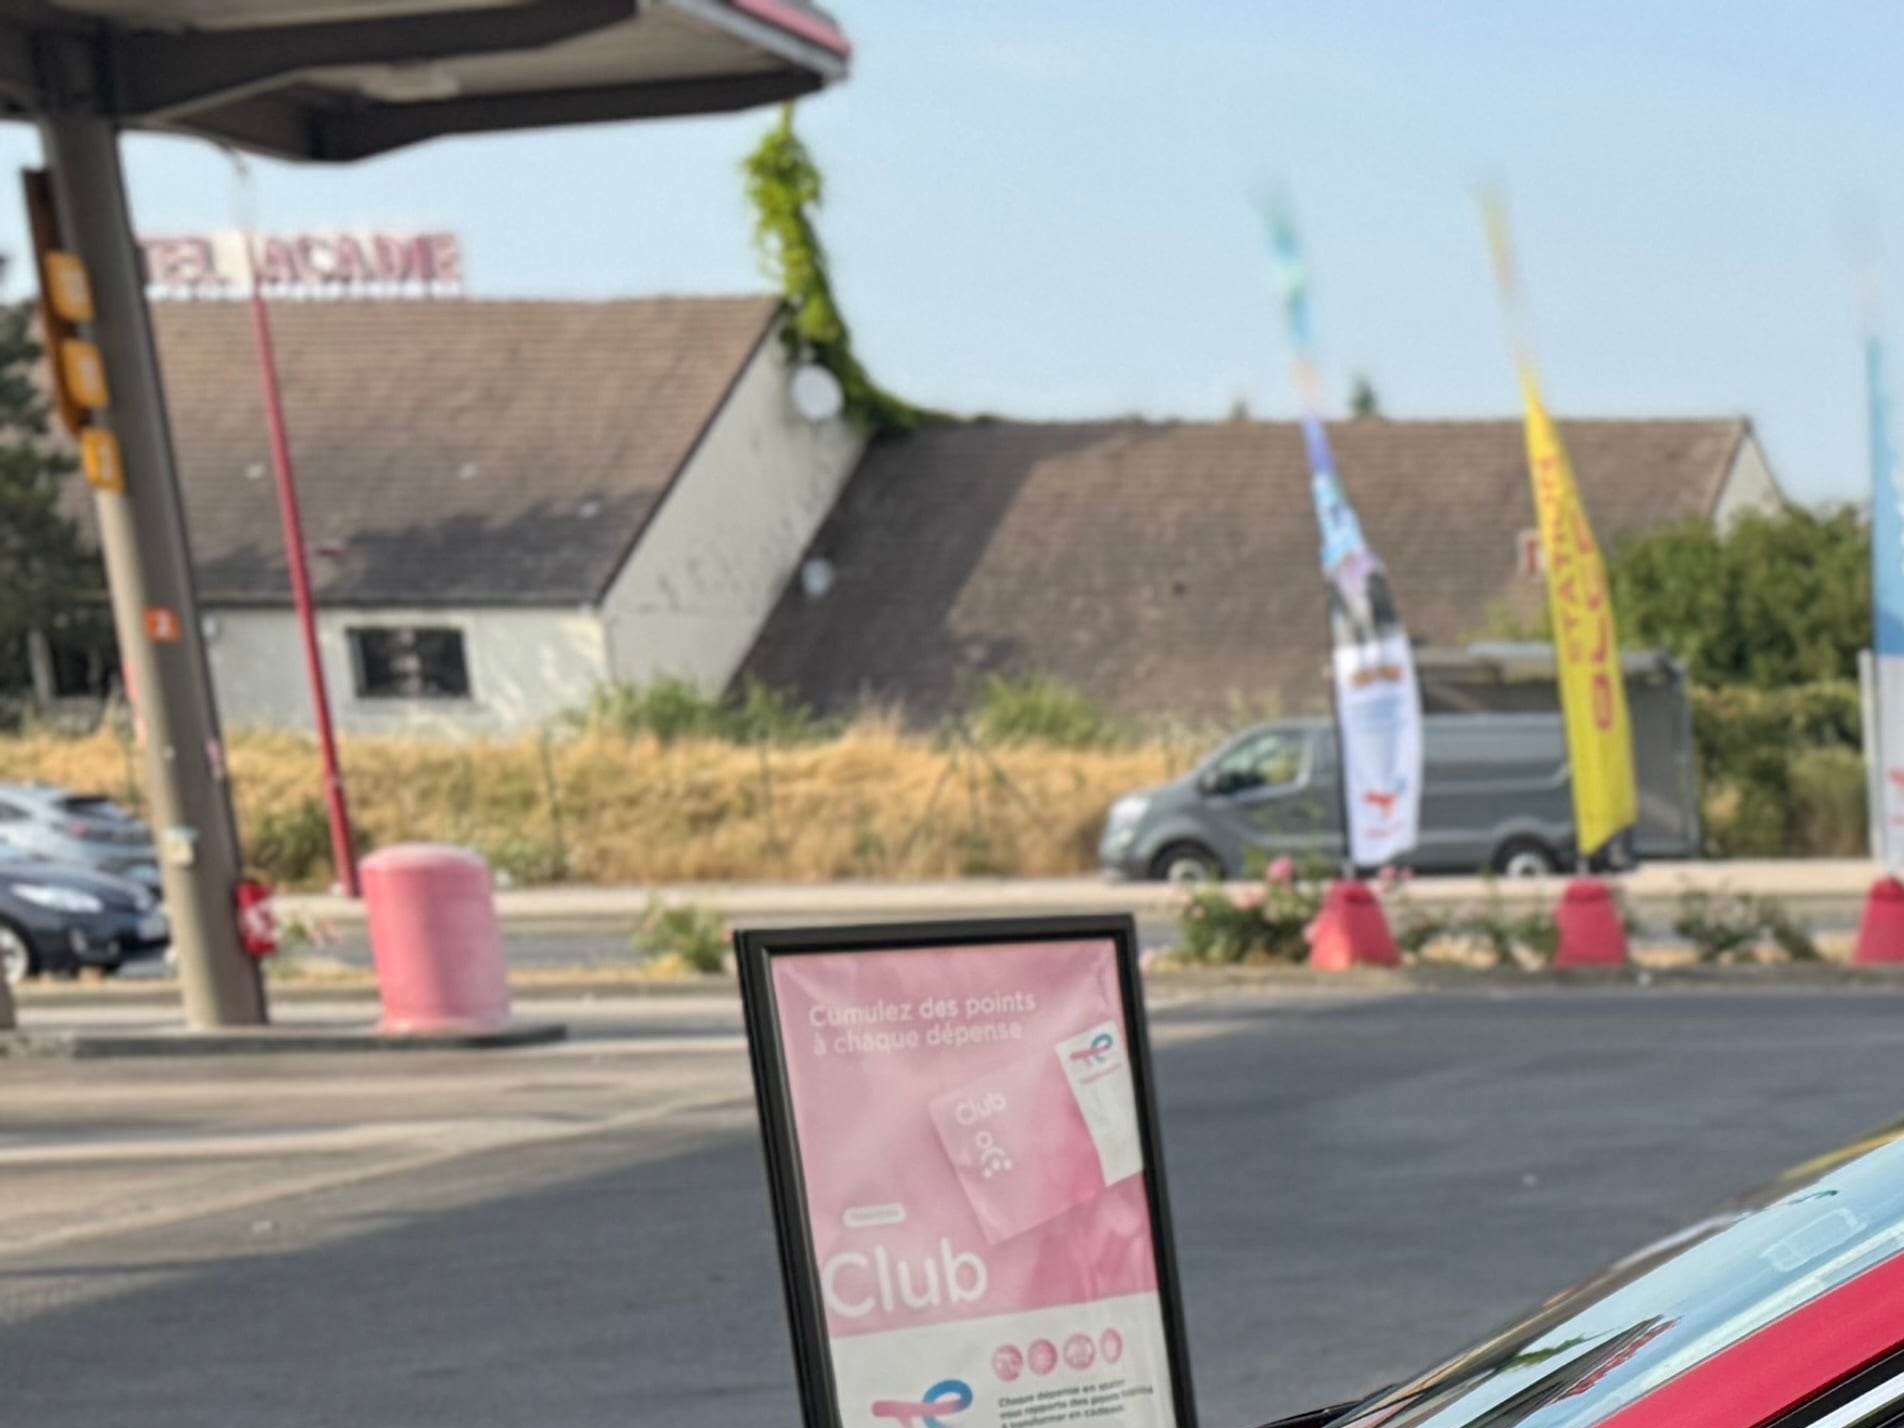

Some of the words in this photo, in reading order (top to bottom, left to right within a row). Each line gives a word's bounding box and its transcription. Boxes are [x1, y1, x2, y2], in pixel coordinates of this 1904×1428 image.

[809, 1001, 912, 1027] Cumulez
[918, 996, 959, 1020] des
[965, 991, 1036, 1020] points
[812, 1031, 827, 1056] à
[833, 1028, 918, 1056] chaque
[926, 1020, 1023, 1047] dépense
[955, 1091, 1007, 1125] Club
[821, 1236, 988, 1319] Club
